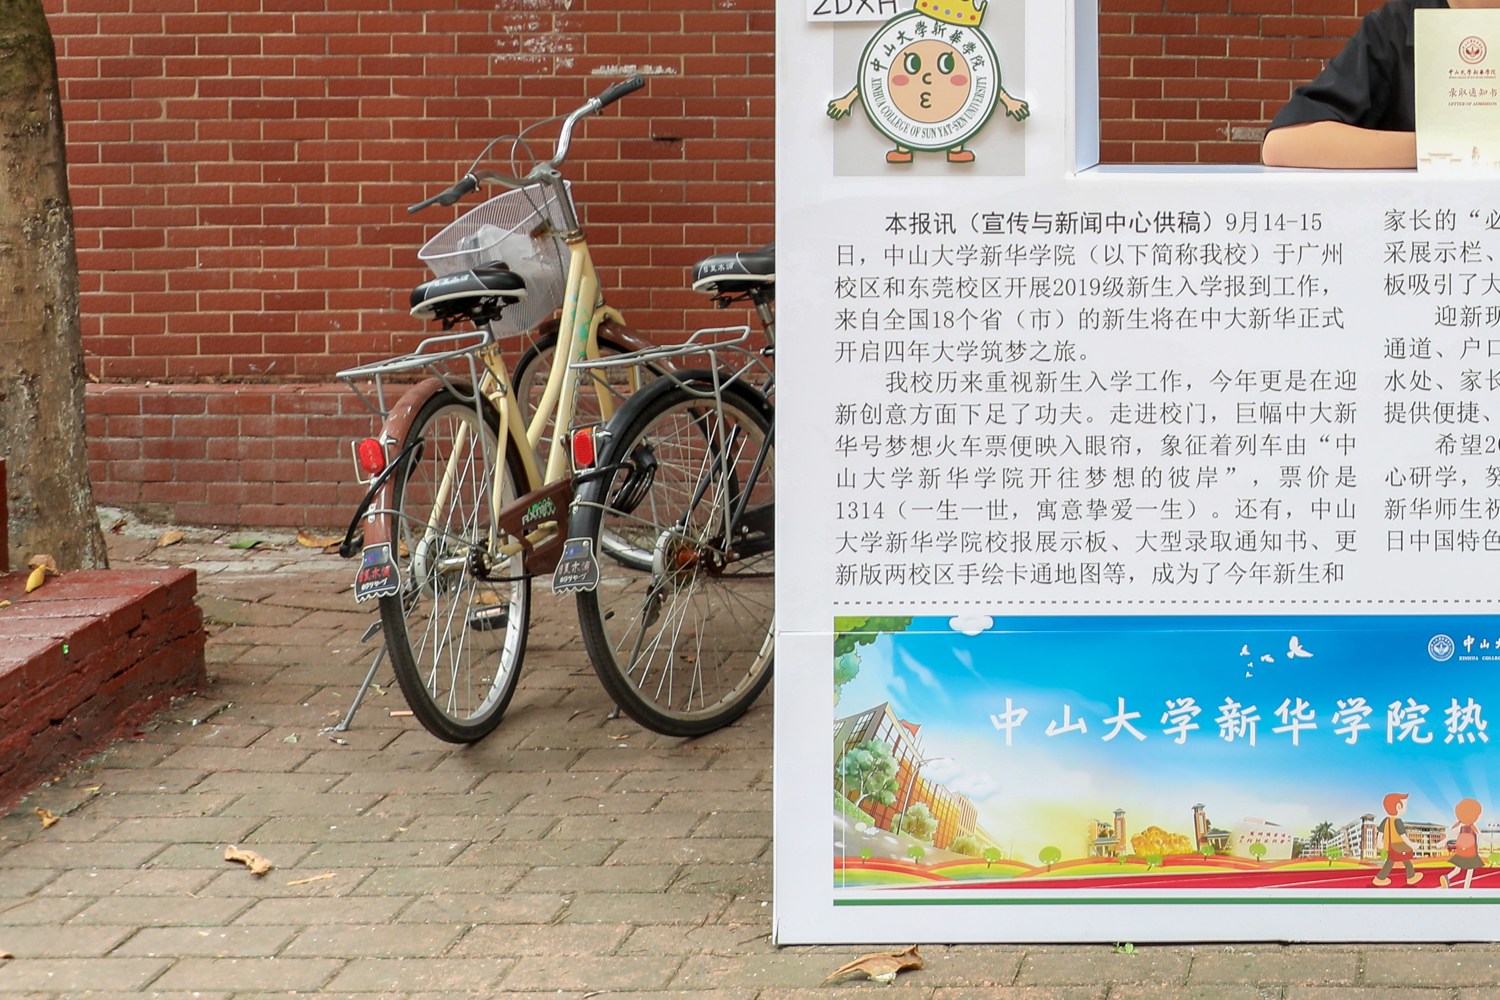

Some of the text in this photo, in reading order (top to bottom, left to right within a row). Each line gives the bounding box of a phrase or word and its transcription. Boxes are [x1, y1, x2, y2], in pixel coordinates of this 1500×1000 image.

[871, 77, 888, 109] XINHUA
[909, 126, 921, 138] OF
[921, 127, 937, 139] SUN
[937, 116, 967, 138] YAT-SEN
[835, 340, 1086, 363] 开启四年大学筑梦之旅。
[886, 369, 1356, 393] 我校历来重视新生入学工作，今年更是在迎
[838, 466, 1356, 489] 山大学新华学院开往梦想的彼岸”，票价是
